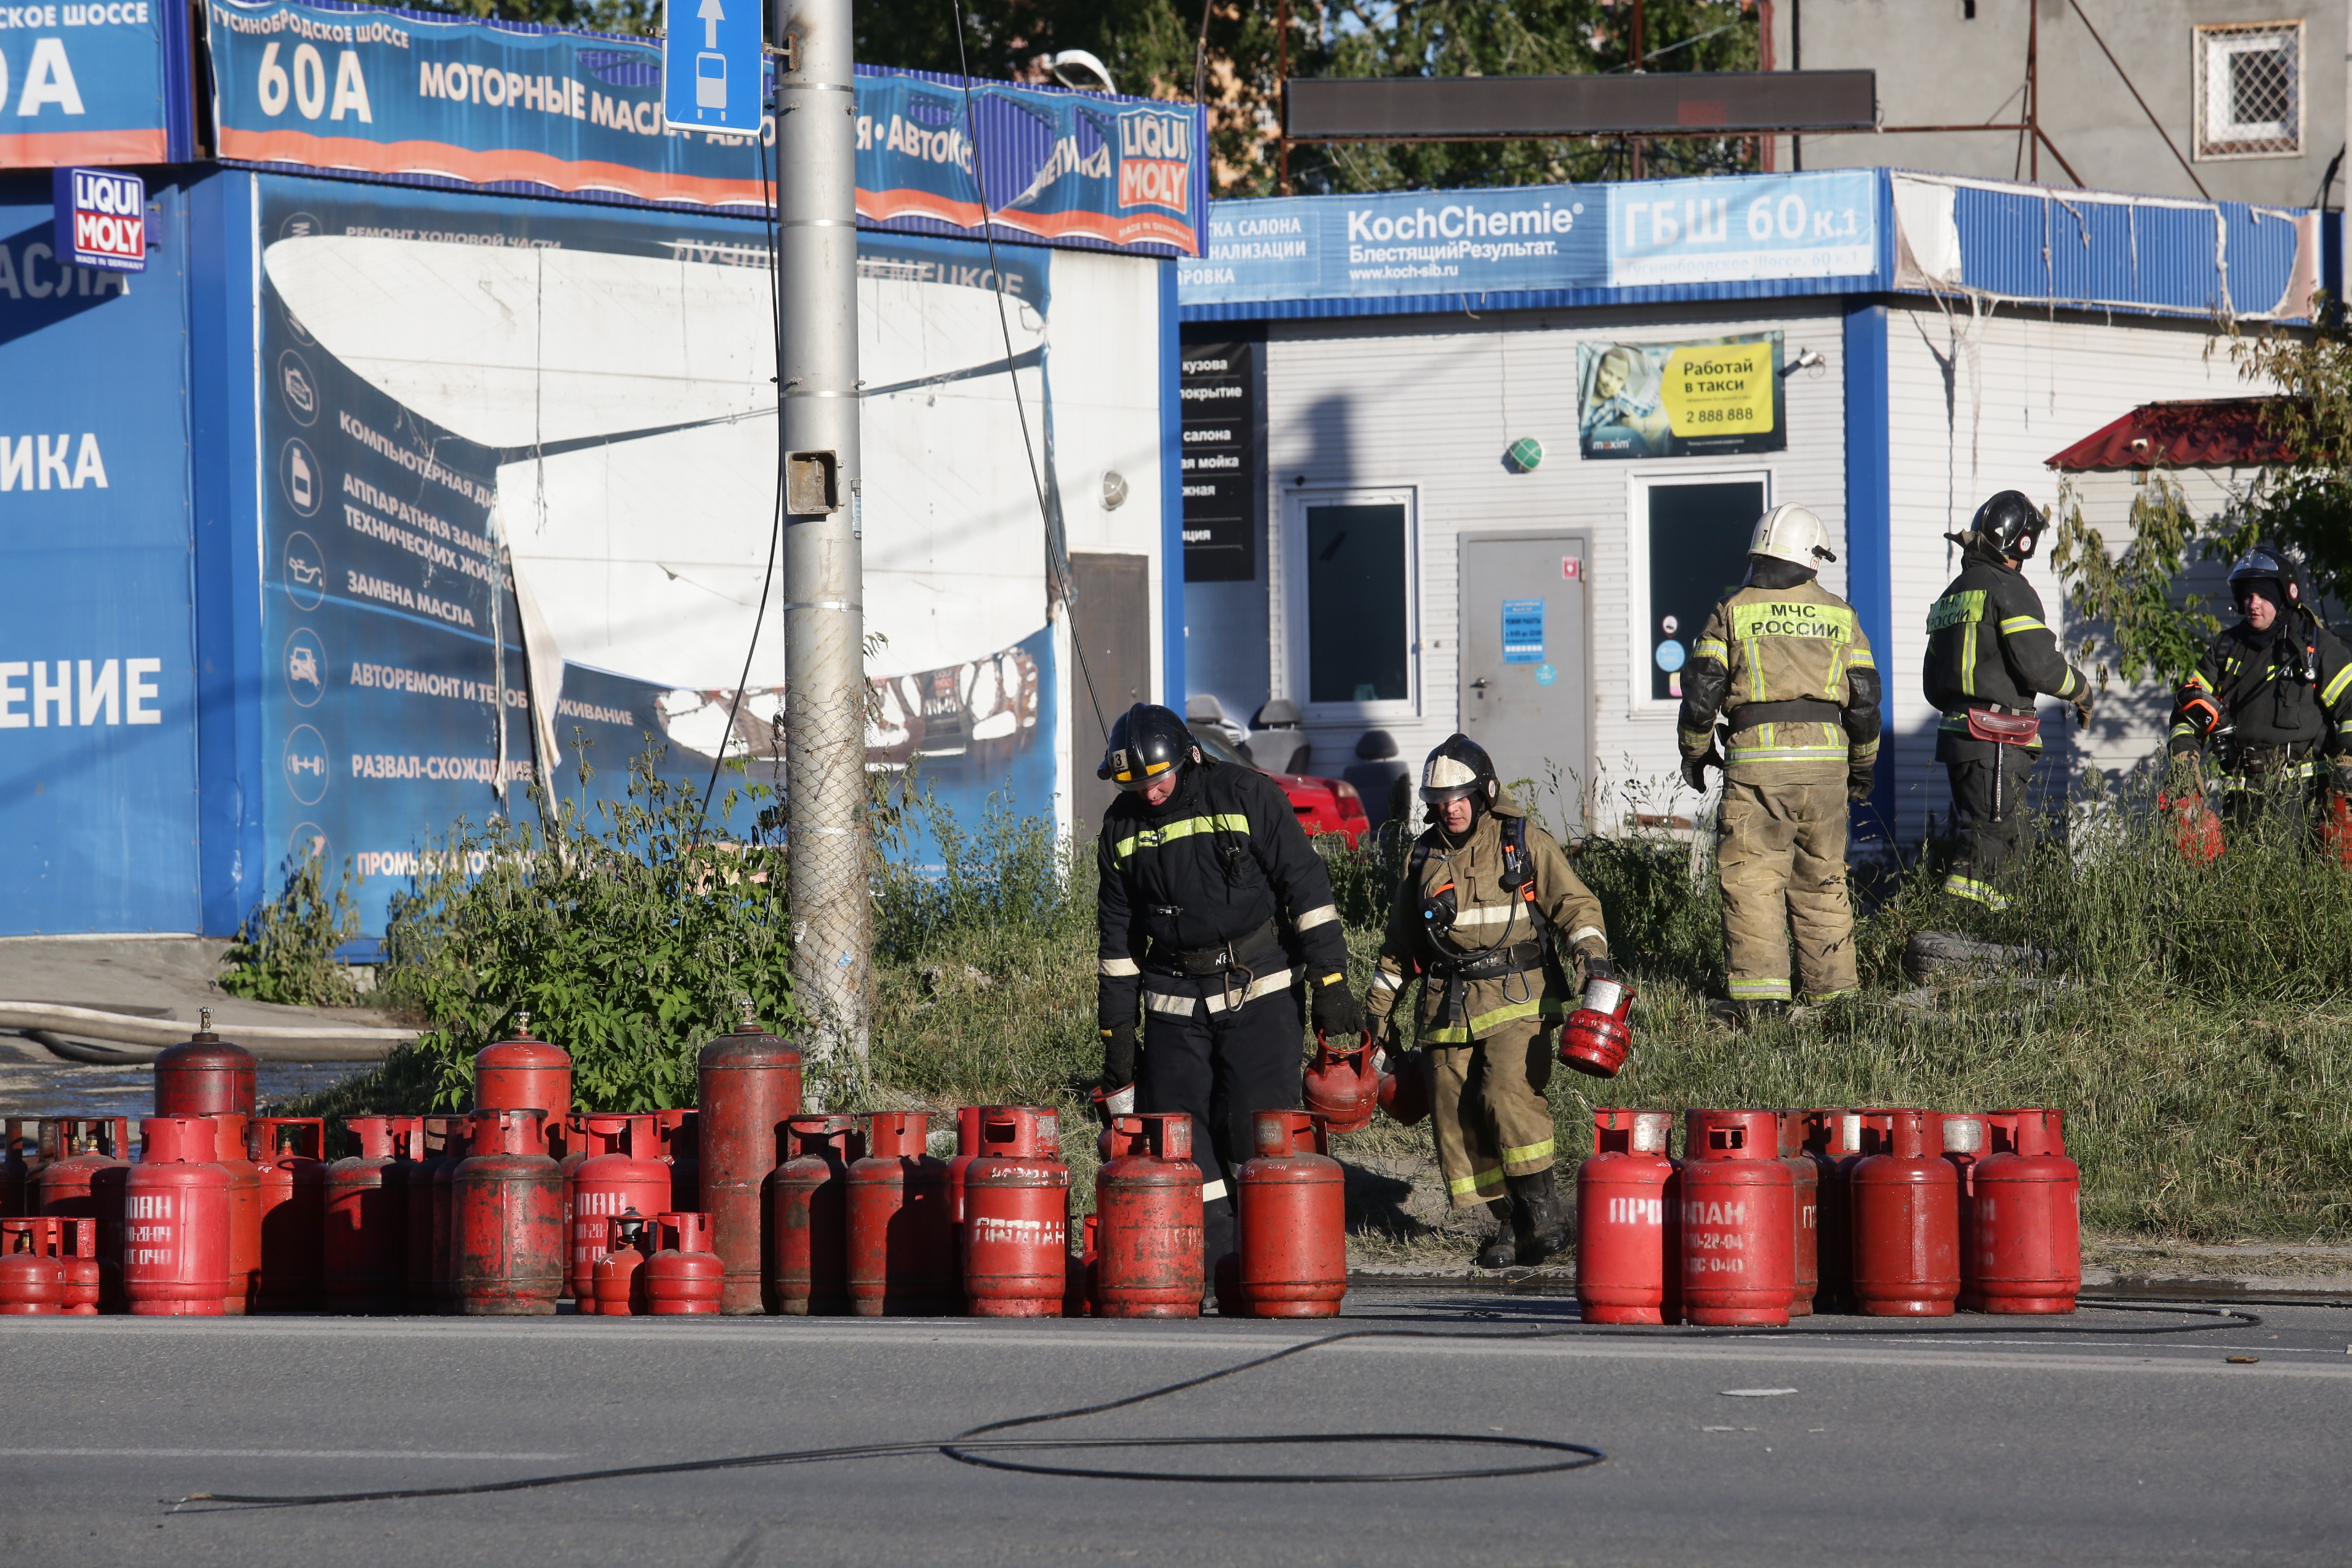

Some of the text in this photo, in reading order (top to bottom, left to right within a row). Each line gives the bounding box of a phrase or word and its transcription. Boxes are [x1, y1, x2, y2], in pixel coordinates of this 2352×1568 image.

[62, 2, 148, 26] ШОССЕ
[213, 7, 409, 49] ГУСИНОБРОДСКОЕ ШОССЕ
[0, 37, 86, 116] А
[258, 42, 372, 124] 60А
[420, 61, 586, 120] МОТОРНЫЕ
[1123, 115, 1187, 160] LIQUI
[76, 175, 140, 216] LIQUI
[1122, 162, 1186, 205] MOLY
[77, 213, 142, 254] MOLY
[1238, 217, 1302, 237] САЛОНА
[1625, 198, 1727, 247] ГБШ
[1747, 194, 1807, 241] 60
[75, 254, 97, 265] MADE
[107, 258, 145, 271] GERMANY
[1349, 264, 1459, 281] www.koch-sib.ru
[1182, 359, 1227, 375] кузова
[1684, 359, 1754, 376] Работай
[1685, 380, 1744, 393] в такси
[1687, 407, 1753, 423] 2 888 888
[1183, 429, 1231, 442] салона
[1198, 455, 1239, 470] мойка
[343, 472, 451, 541] АППАРАТНАЯ
[344, 503, 458, 571] ТЕХНИЧЕСКИХ
[1762, 529, 1768, 541] 7
[347, 570, 475, 627] ЗАМЕНА МАСЛА
[1771, 604, 1816, 618] МЧС
[1751, 620, 1839, 638] РОССИИ
[350, 662, 461, 699] АВТОРЕМОНТ
[463, 680, 475, 701] И
